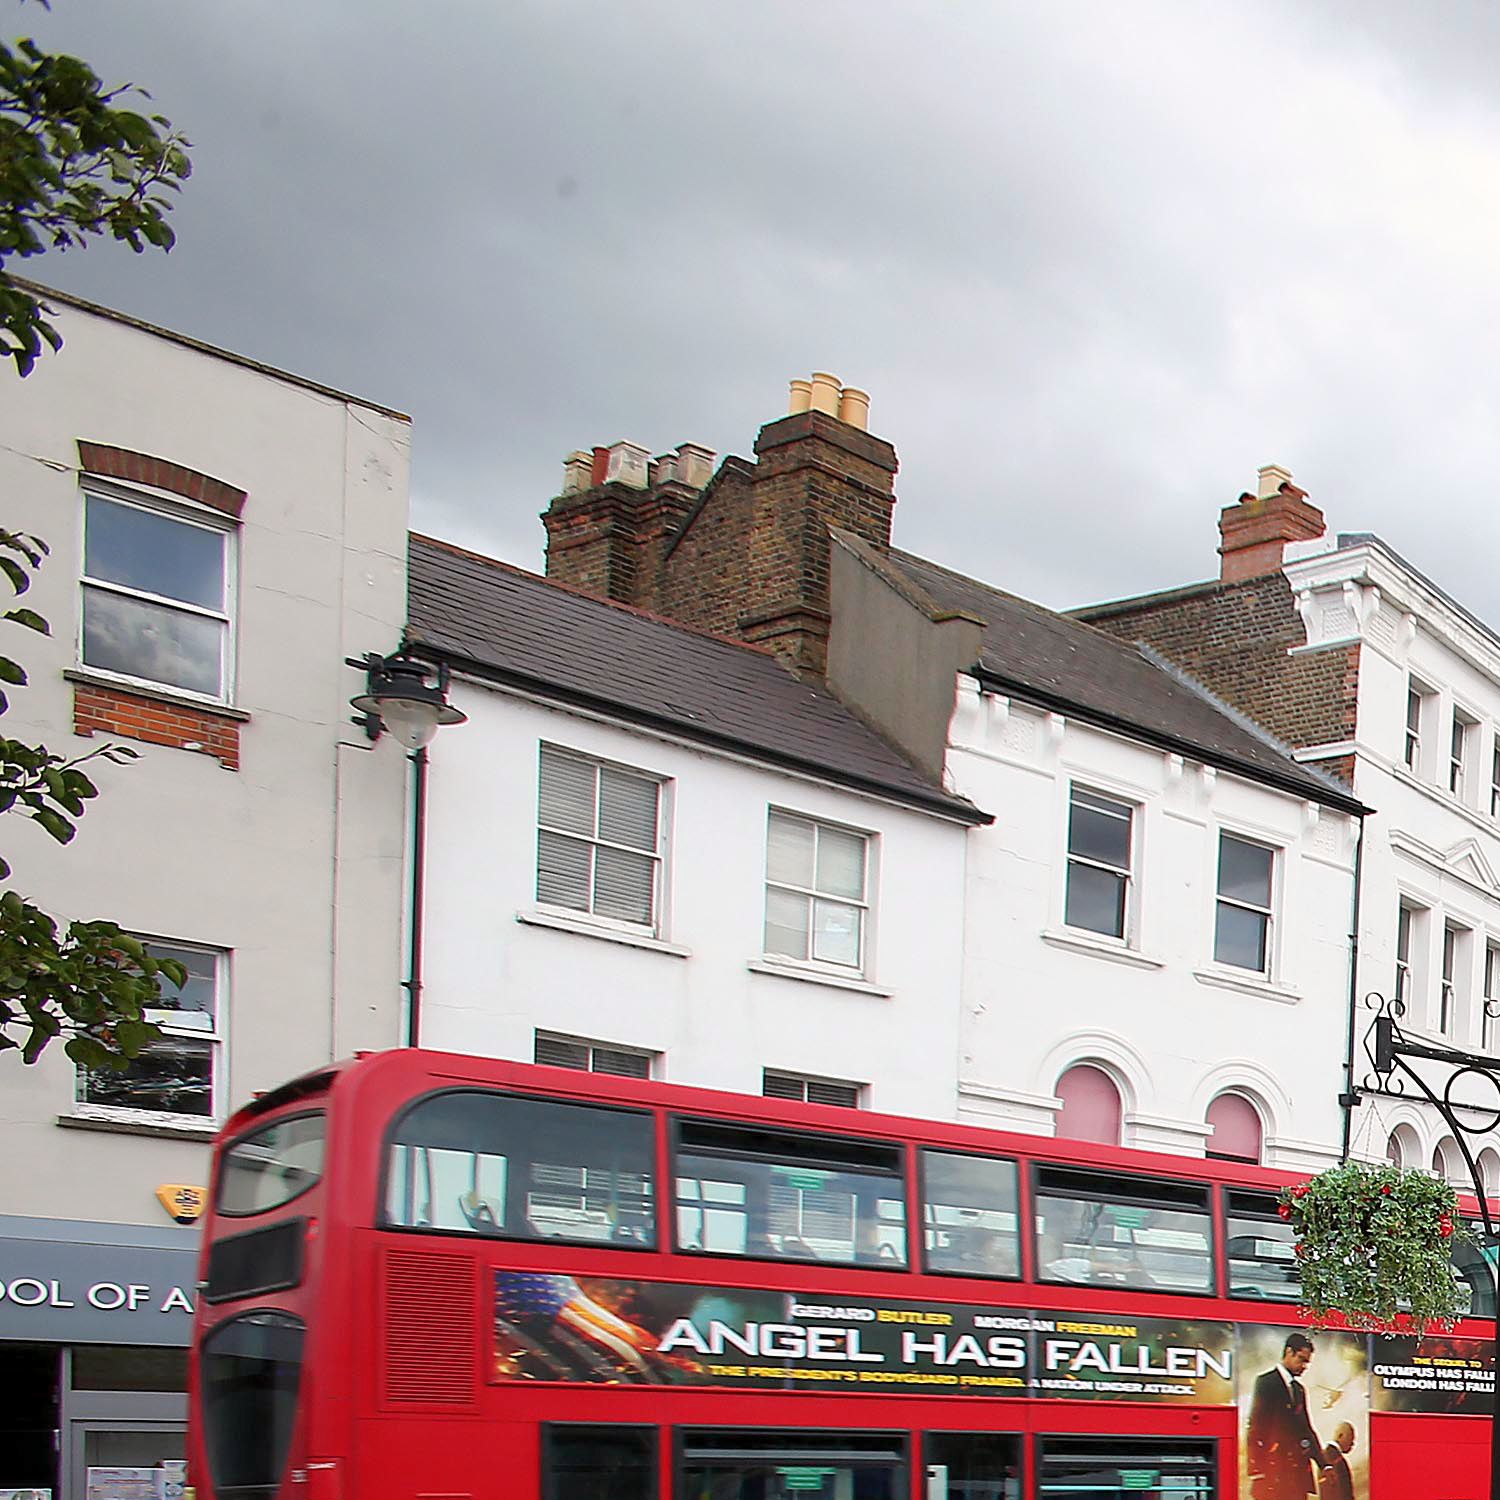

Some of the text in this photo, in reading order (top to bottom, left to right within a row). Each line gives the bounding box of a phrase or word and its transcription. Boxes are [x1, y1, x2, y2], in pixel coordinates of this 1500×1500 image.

[0, 1277, 75, 1308] OL
[87, 1282, 150, 1311] OF
[791, 1304, 953, 1326] GERARD BUTLER
[973, 1316, 1137, 1337] MORGAN FREEMAN
[656, 1317, 1232, 1379] ANGEL HAS FALLEN
[1373, 1364, 1496, 1380] OLYMPUS HAS FALLE
[1411, 1356, 1482, 1368] THE SEQUEL TO
[708, 1364, 746, 1376] THE
[747, 1366, 858, 1382] PRESIDENT'S
[858, 1371, 959, 1385] BODYGUARD
[1041, 1378, 1093, 1390] NATION
[1094, 1380, 1142, 1393] UNDER
[1383, 1377, 1495, 1393] LONDON HAS FALL
